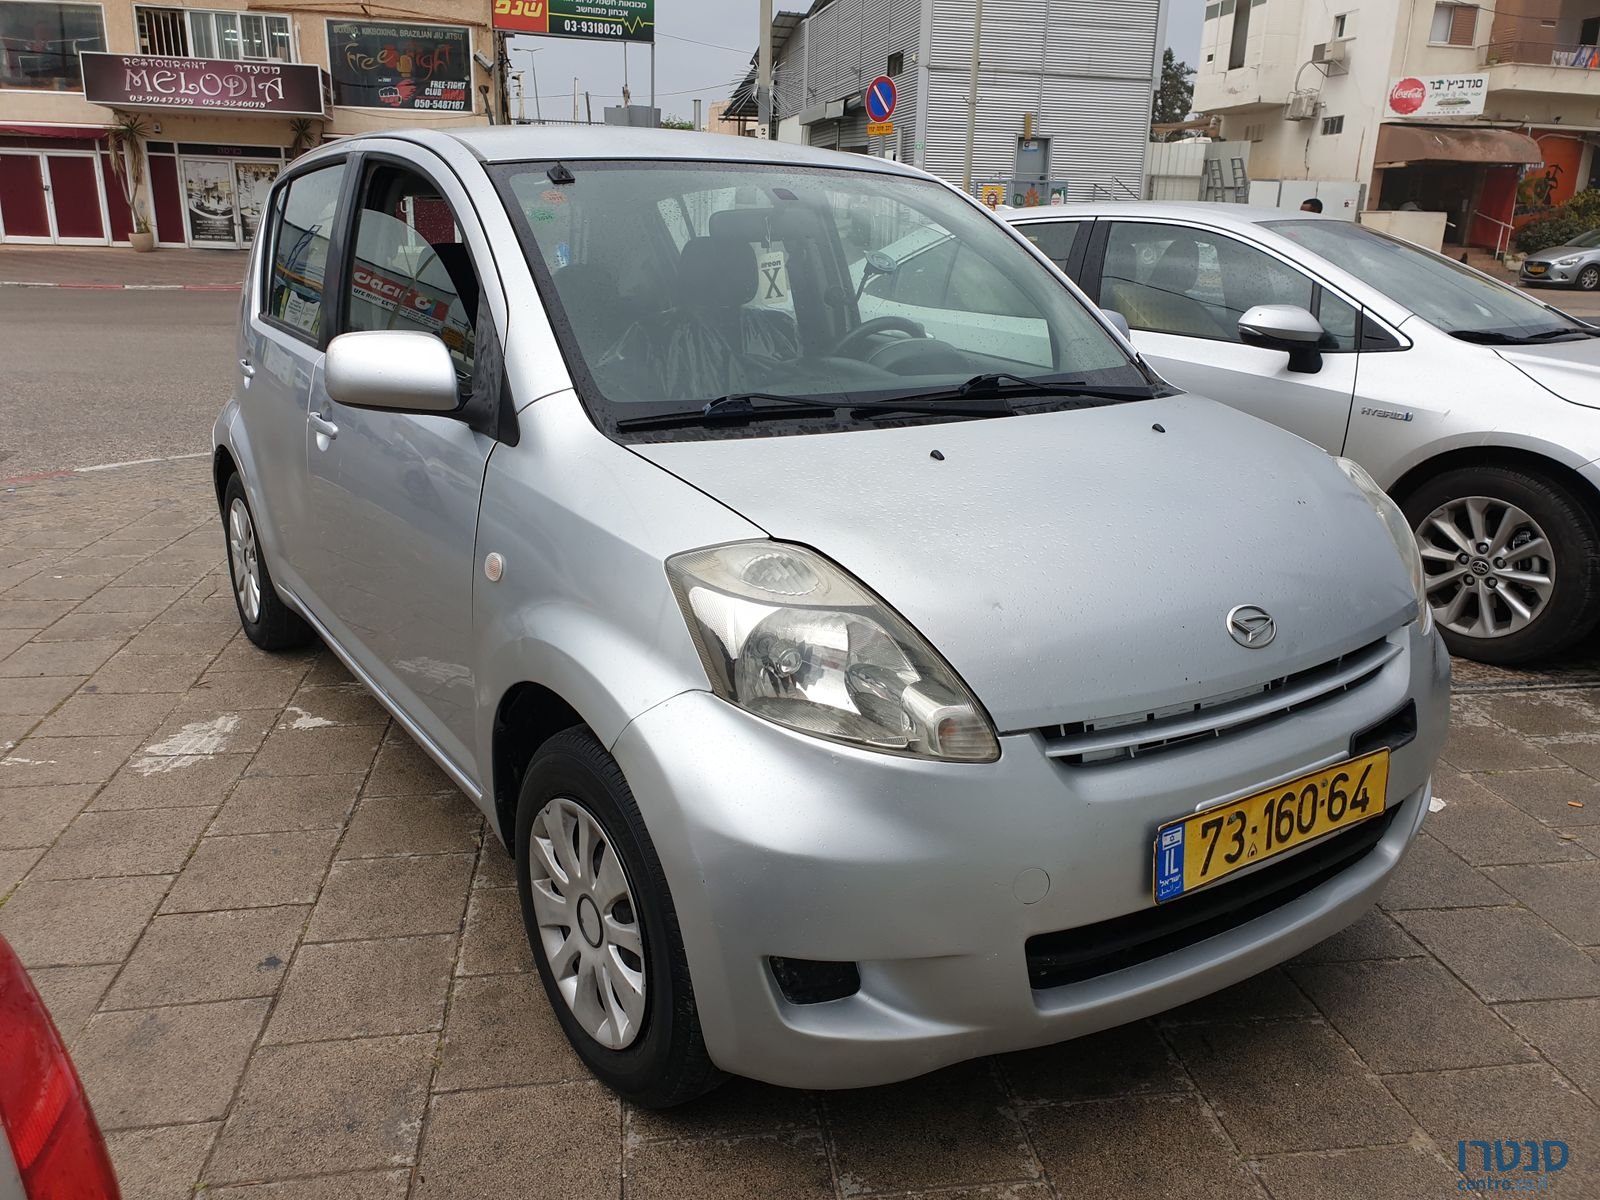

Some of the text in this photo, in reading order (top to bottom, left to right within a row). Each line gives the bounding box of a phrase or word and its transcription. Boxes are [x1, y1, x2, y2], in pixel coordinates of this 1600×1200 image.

[575, 6, 629, 17] אבחון ממוחשב
[564, 19, 623, 35] 03-9318020
[234, 64, 281, 75] מסעדה
[124, 68, 285, 103] MELODIA
[424, 88, 442, 96] CLUB
[129, 94, 266, 109] 03-9047598 054-5246018
[761, 267, 785, 300] X
[1361, 406, 1405, 421] HYBRID
[1165, 848, 1179, 877] IL
